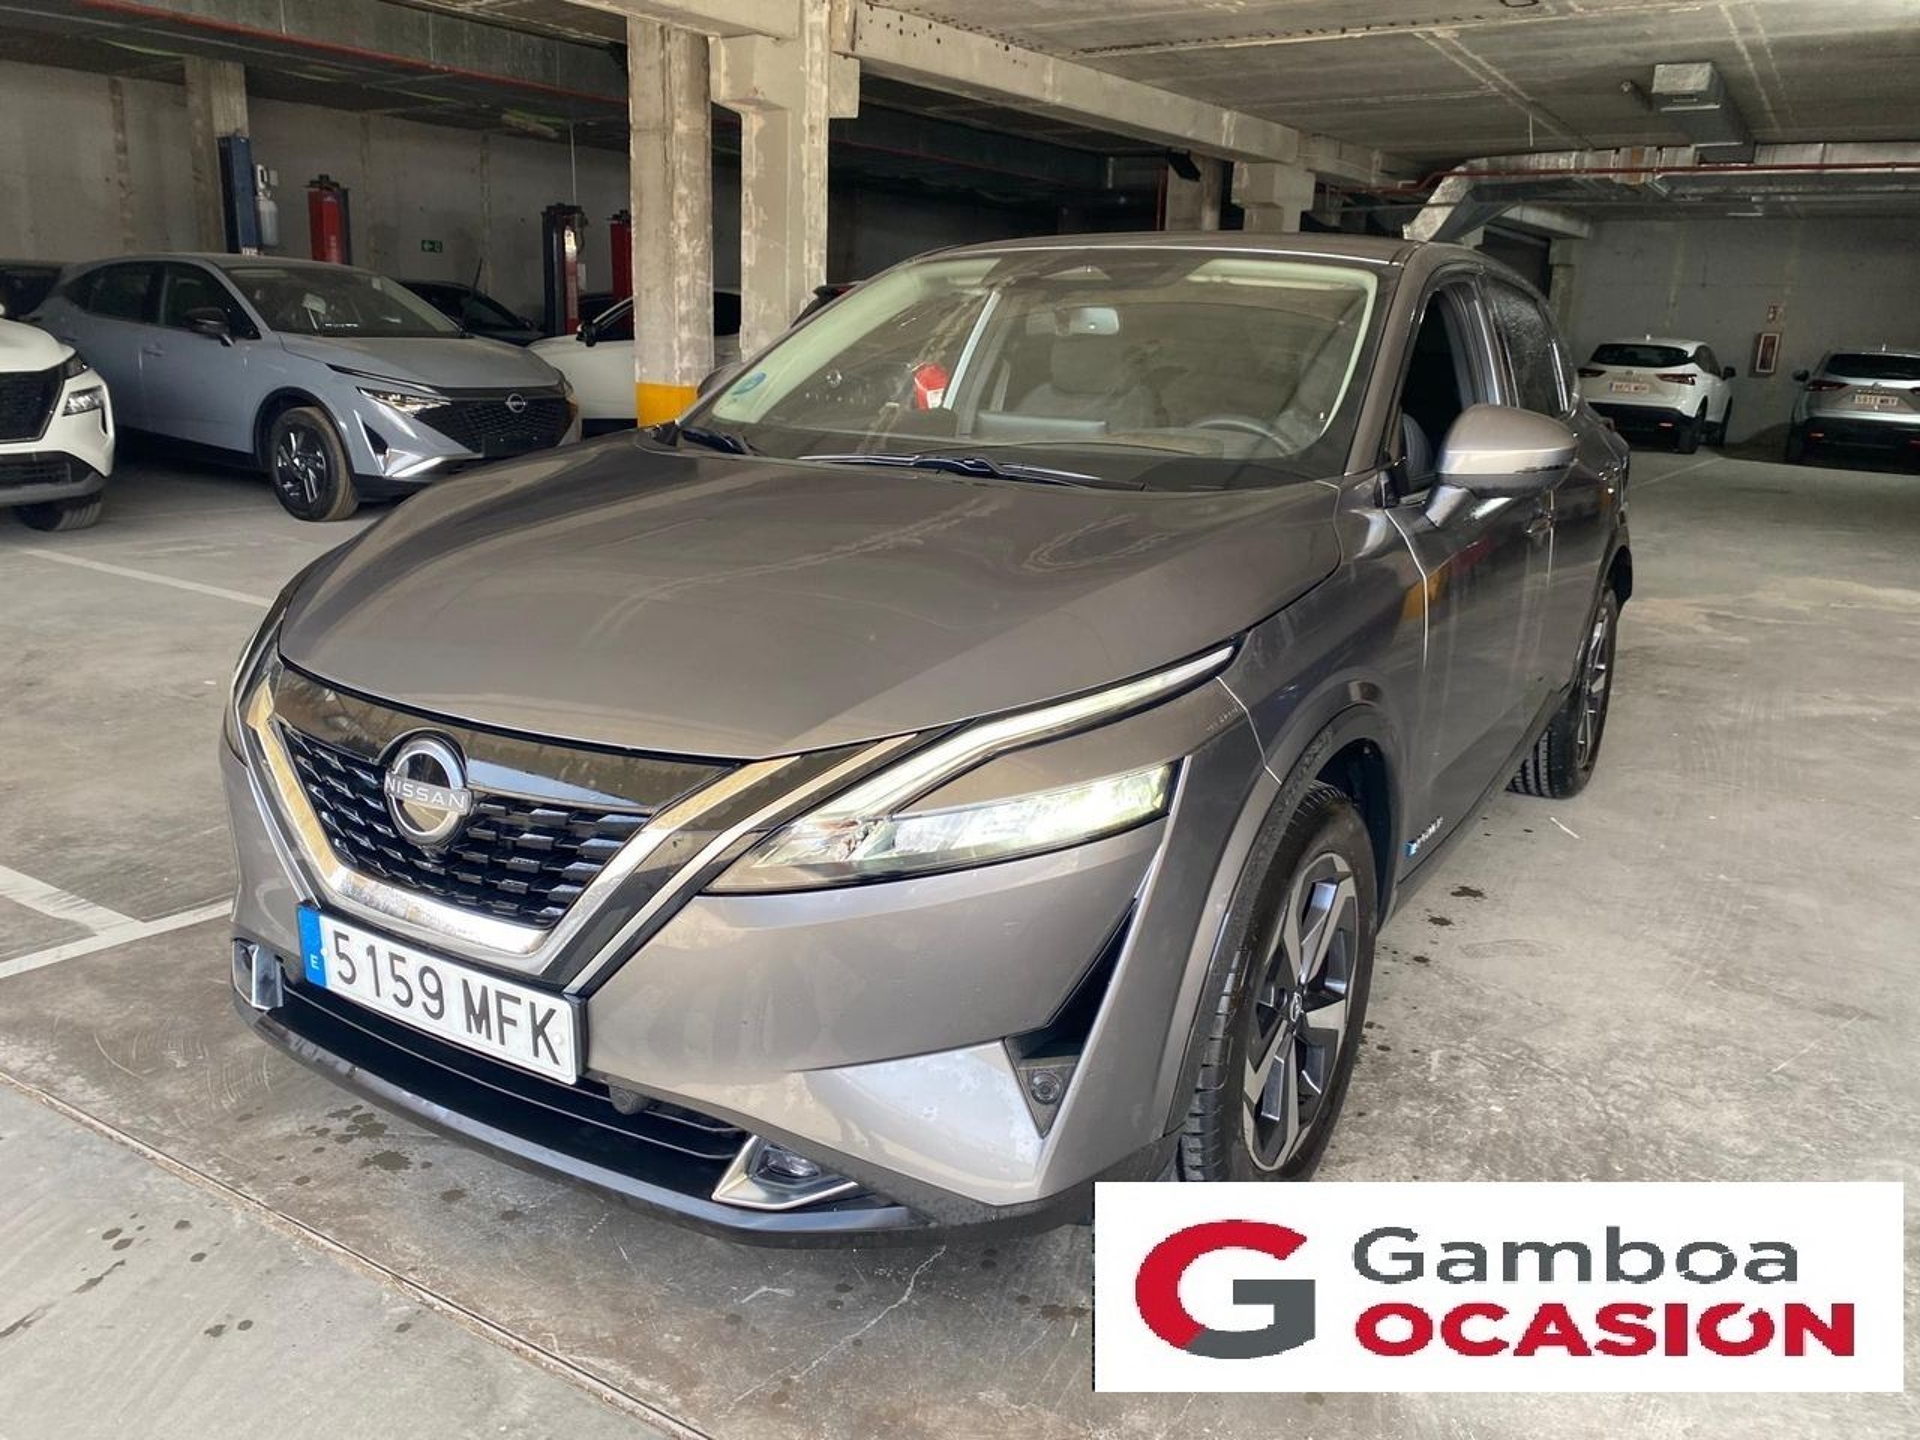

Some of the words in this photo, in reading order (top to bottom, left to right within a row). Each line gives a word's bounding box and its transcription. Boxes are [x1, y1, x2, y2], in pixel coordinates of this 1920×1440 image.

[385, 775, 465, 808] NISSAN
[310, 953, 320, 970] E
[333, 929, 445, 1020] 5159
[461, 978, 561, 1066] MFK
